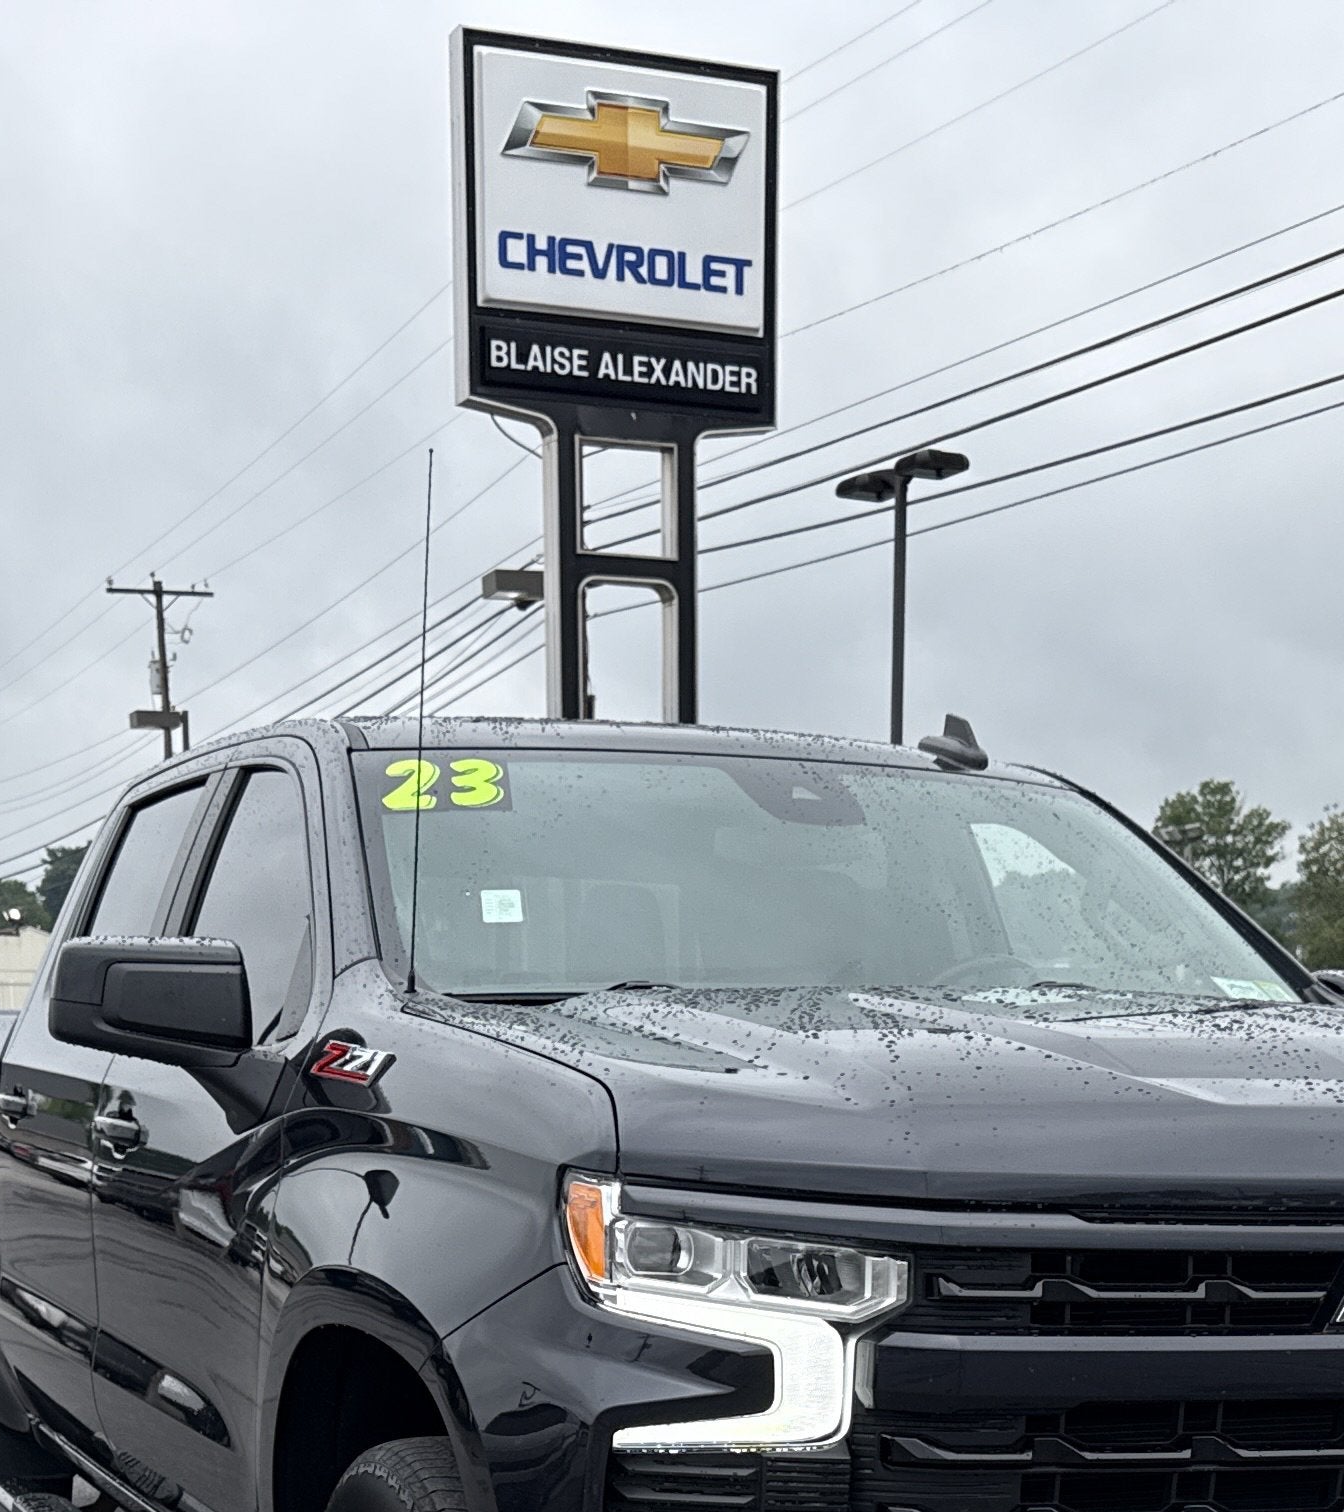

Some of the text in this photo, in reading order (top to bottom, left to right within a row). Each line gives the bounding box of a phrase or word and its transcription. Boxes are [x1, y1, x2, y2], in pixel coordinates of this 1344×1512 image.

[497, 230, 753, 297] CHEVROLET
[489, 339, 758, 396] BLAISE ALEXANDER
[382, 758, 505, 811] 23
